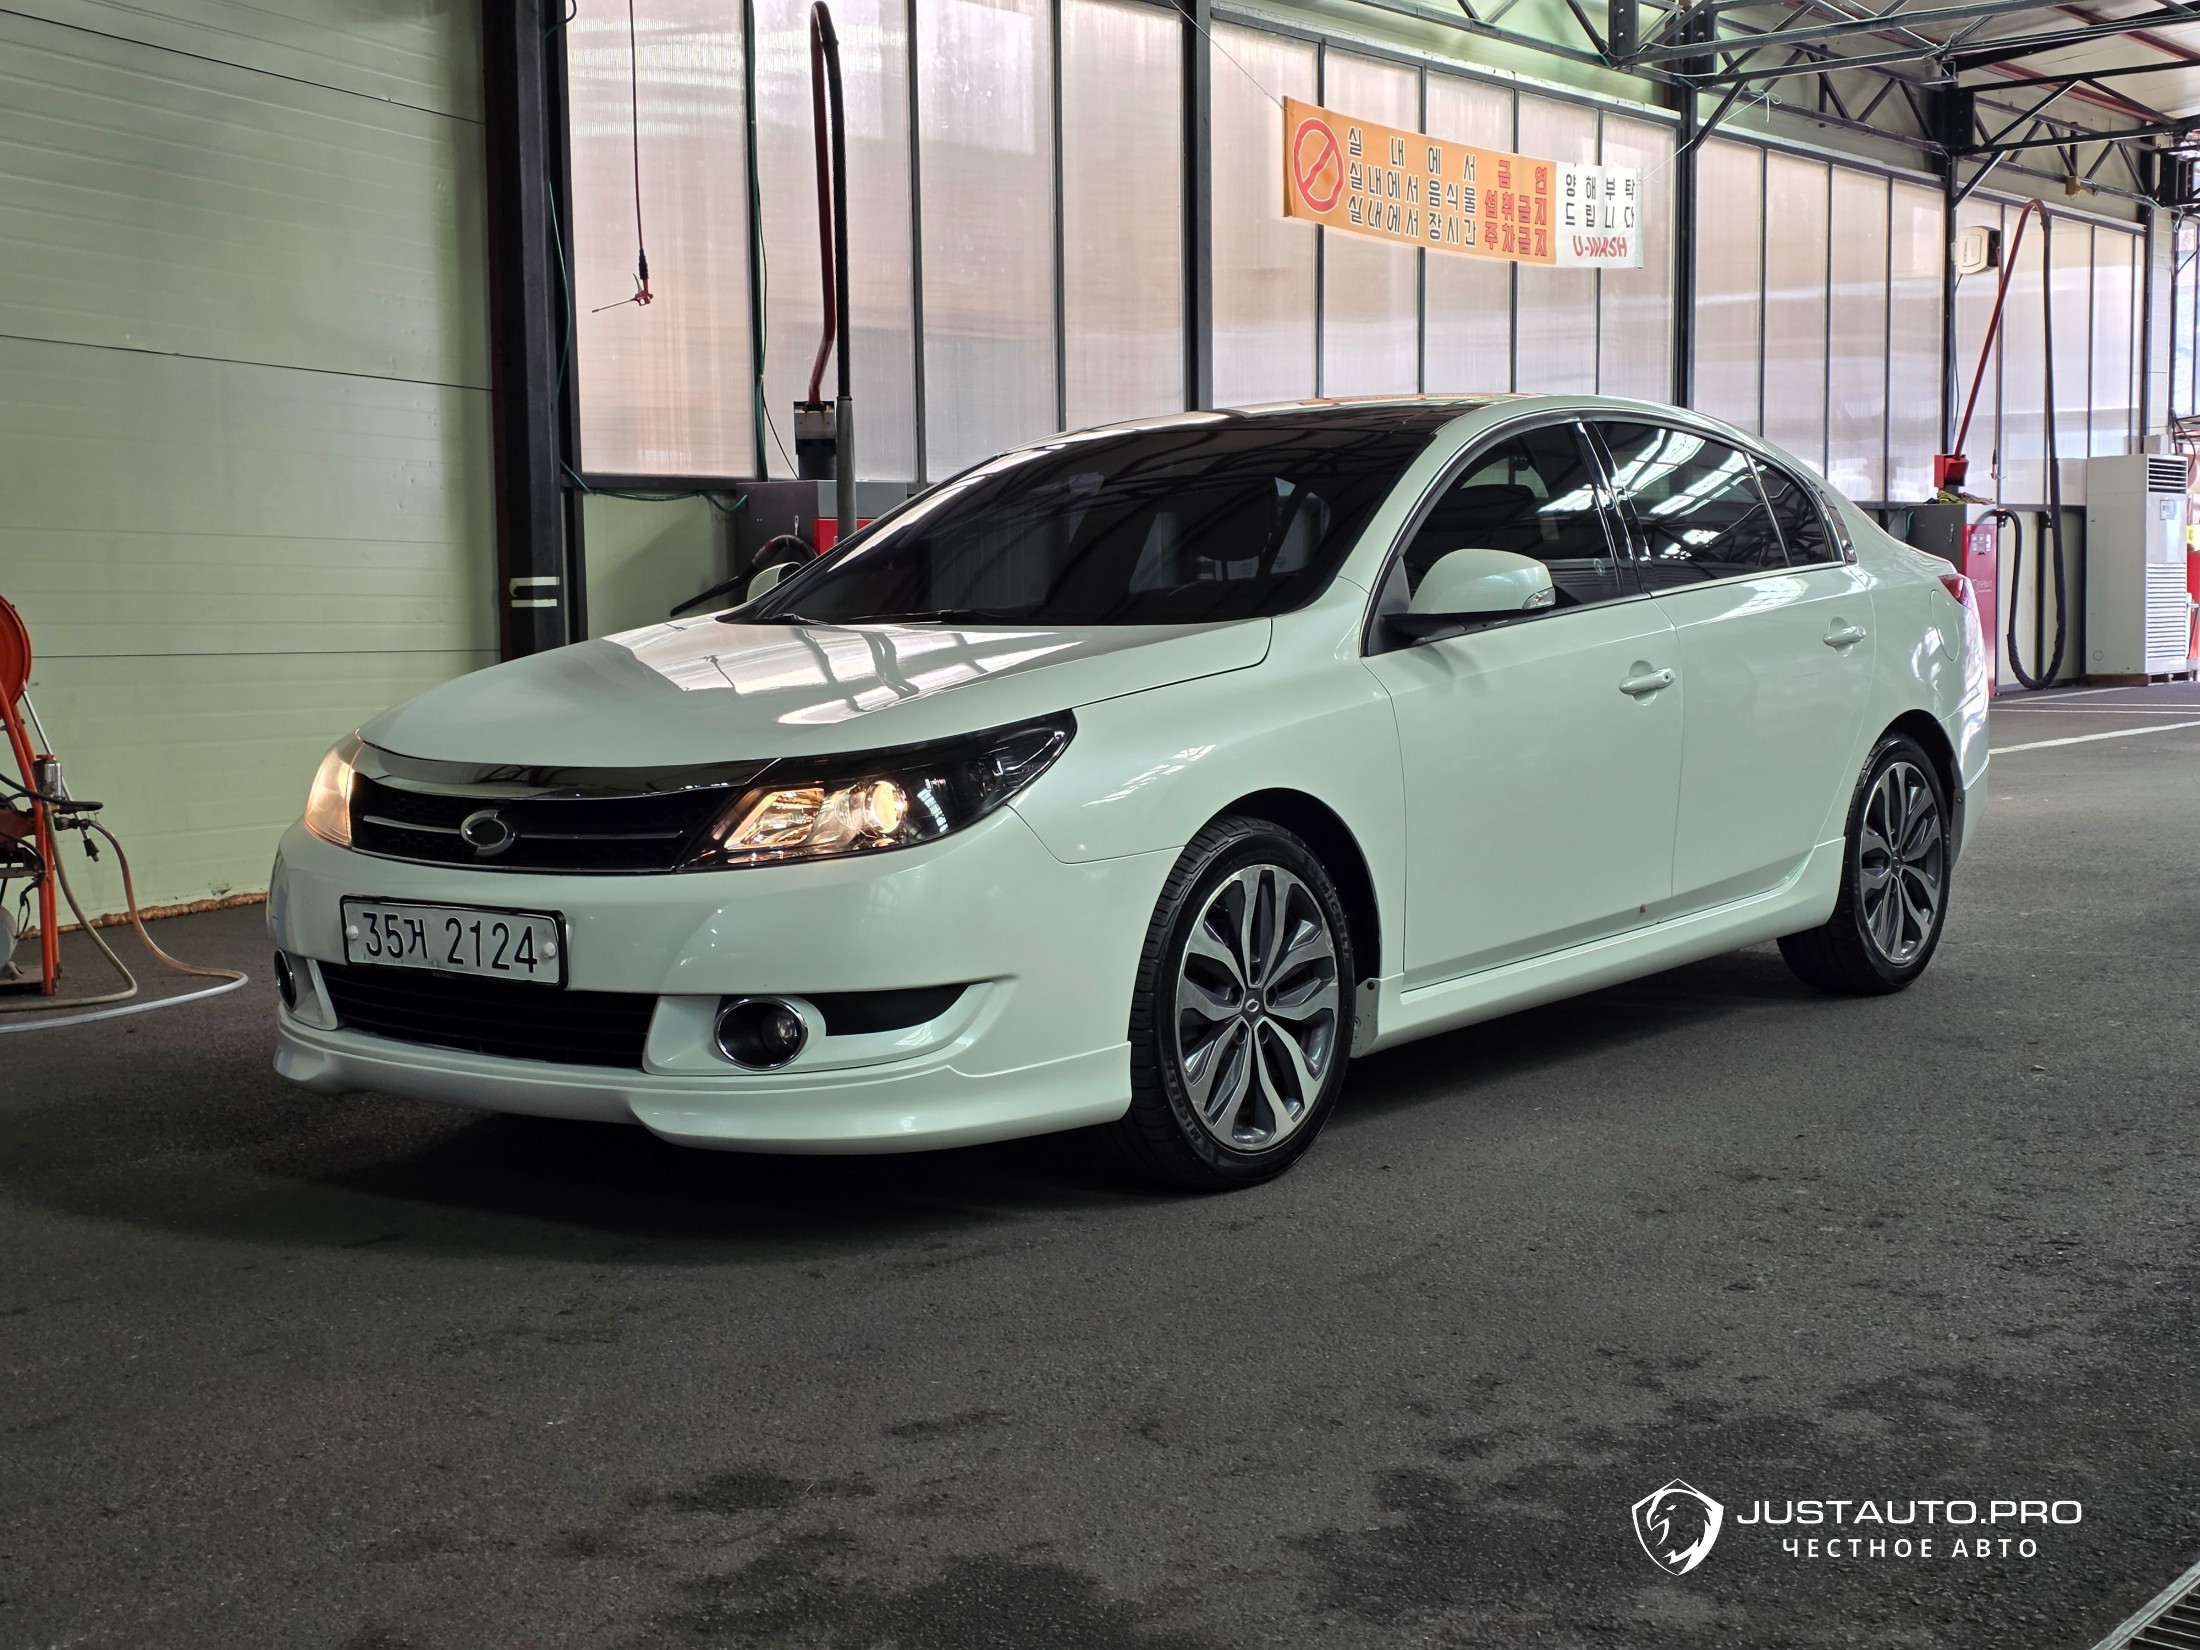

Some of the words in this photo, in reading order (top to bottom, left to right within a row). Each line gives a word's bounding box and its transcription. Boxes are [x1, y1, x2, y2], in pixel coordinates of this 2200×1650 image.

[1349, 161, 1419, 204] 실내에서
[1428, 179, 1477, 214] 음식물
[1348, 195, 1419, 237] 실내에서
[1428, 212, 1477, 246] 장시간
[1572, 235, 1628, 257] U-WASH
[362, 911, 429, 960] 35거
[445, 917, 538, 973] 2124
